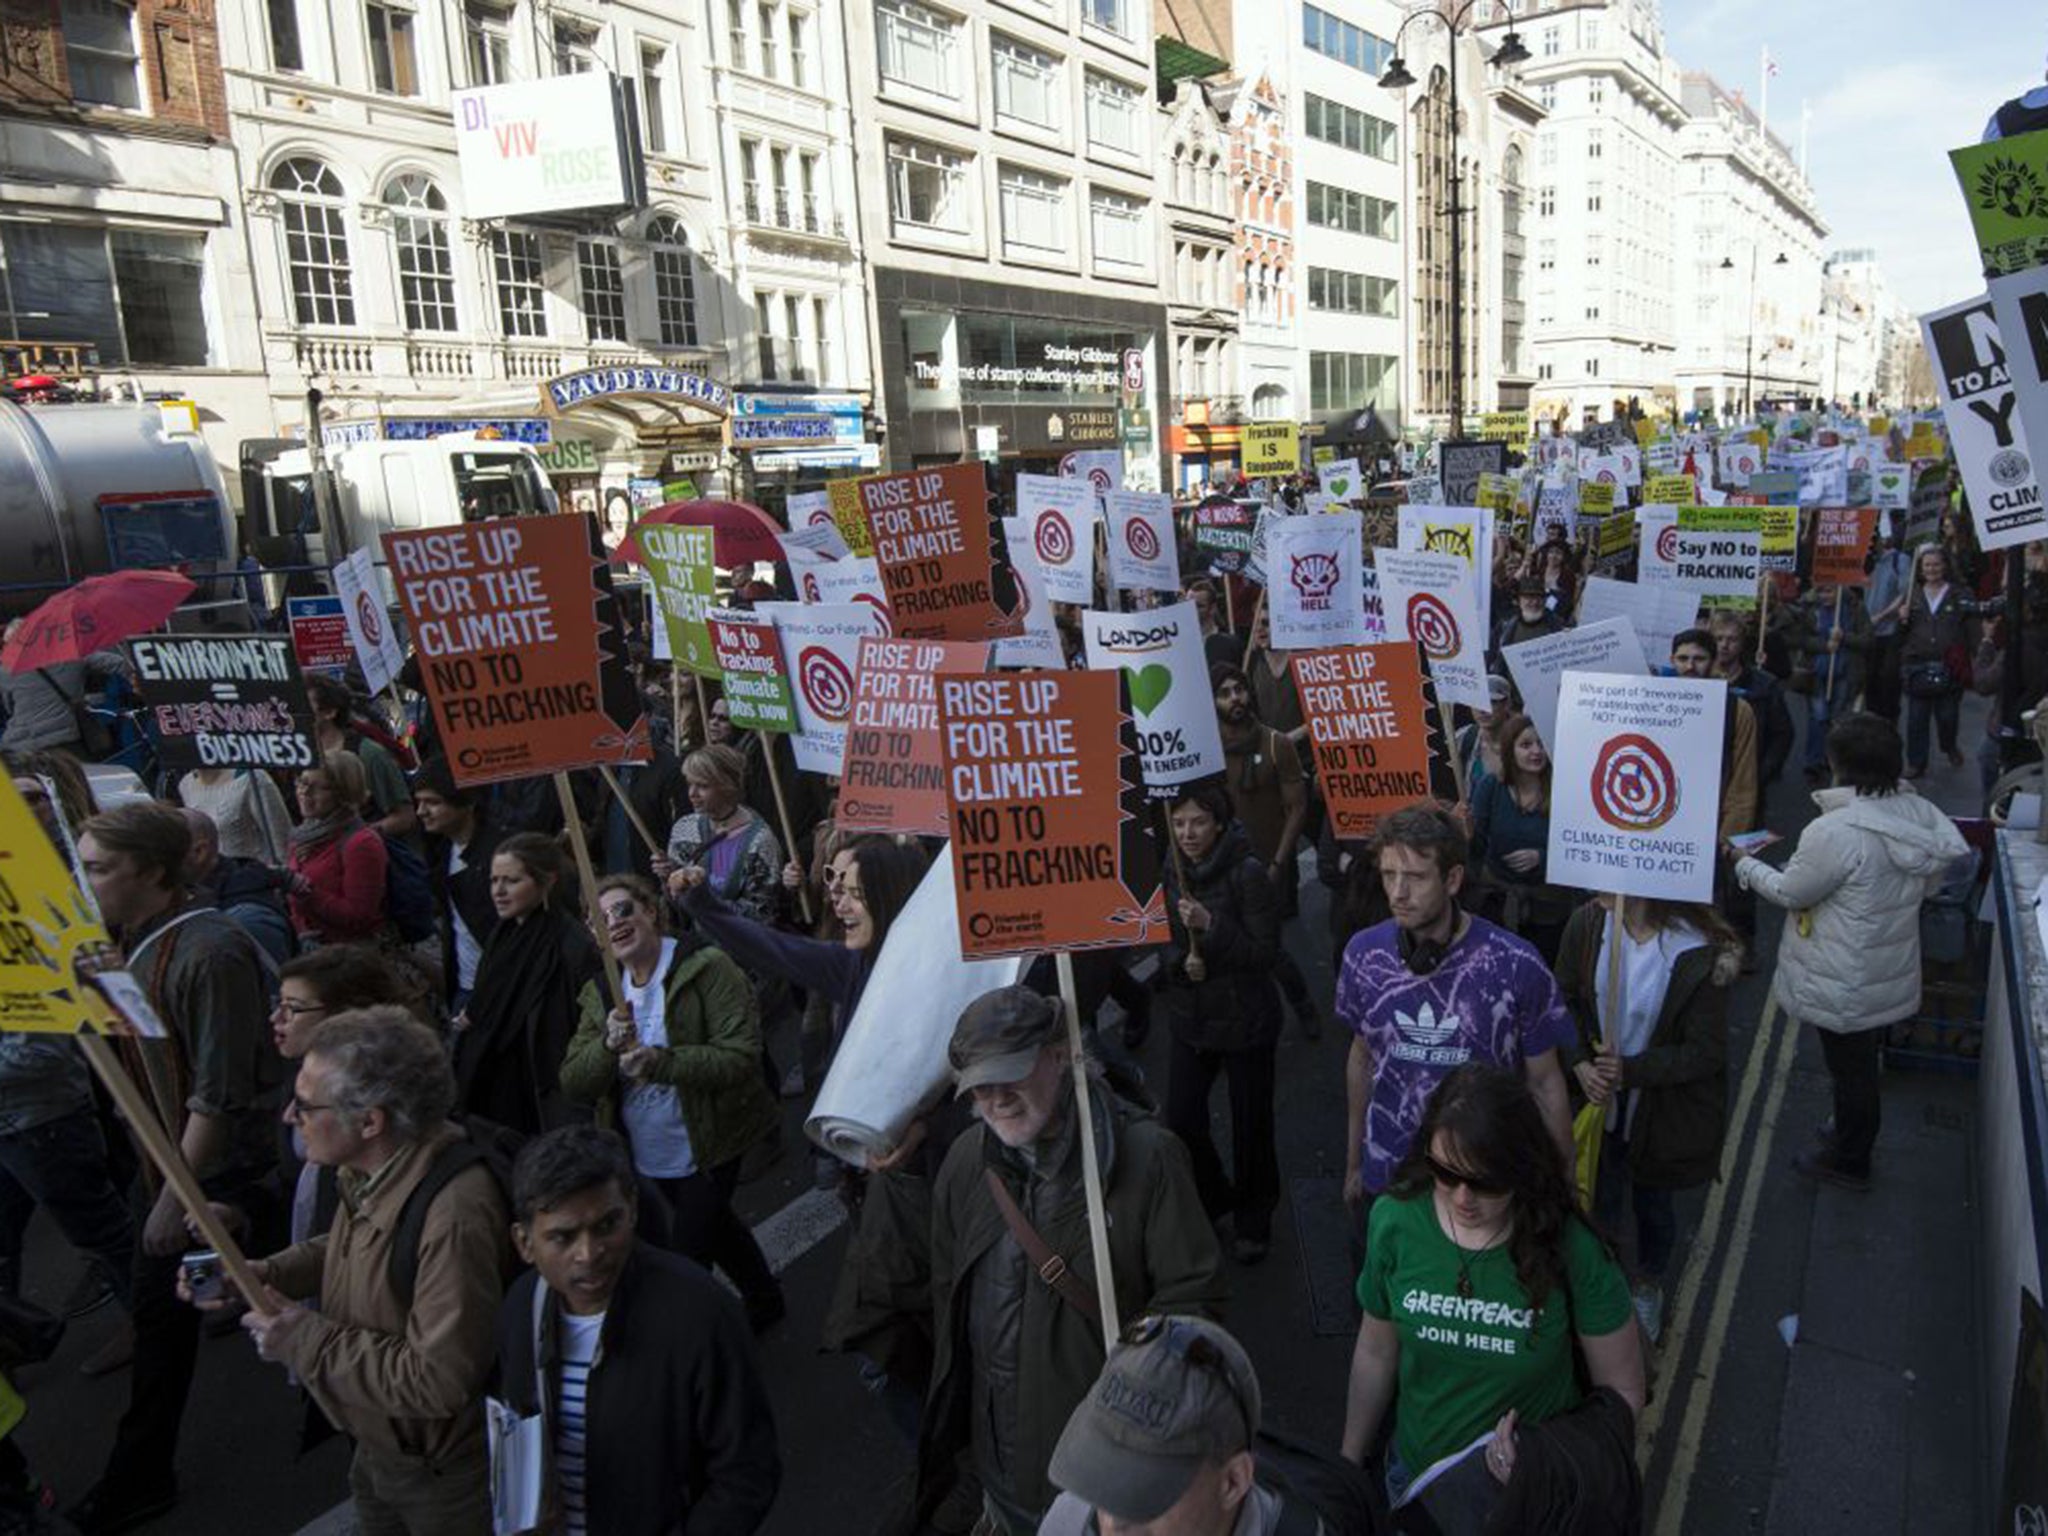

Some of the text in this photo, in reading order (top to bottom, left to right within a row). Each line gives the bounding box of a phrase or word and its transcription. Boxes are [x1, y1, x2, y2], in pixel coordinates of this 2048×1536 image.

[462, 96, 488, 131] DI
[494, 121, 537, 159] VIV
[541, 146, 611, 187] ROSE
[1044, 344, 1119, 365] Stanley Gibbons
[556, 369, 725, 406] VAUDEVILLE
[990, 369, 1023, 386] stamp
[1950, 376, 1983, 396] TO
[1069, 412, 1115, 426] STANLEY
[1070, 428, 1115, 440] GIBBONS
[541, 440, 595, 469] ROSE
[1262, 443, 1278, 457] IS
[864, 474, 943, 509] RISE UP
[871, 508, 914, 537] FOR
[915, 500, 959, 529] THE
[393, 528, 522, 576] RISE UP
[878, 527, 965, 564] CLIMATE
[1678, 540, 1757, 560] Say NO to
[885, 560, 943, 590] NO TO
[1677, 564, 1756, 580] FRACKING
[404, 567, 547, 617] FOR THE
[893, 580, 990, 617] FRACKING
[1301, 599, 1332, 612] HELL
[419, 607, 558, 657] CLIMATE
[718, 623, 760, 650] No to
[1098, 622, 1178, 650] LONDON
[132, 640, 289, 681] ENVIRONMENT
[862, 643, 944, 671] RISE UP
[1296, 652, 1376, 684] RISE UP
[430, 653, 523, 695] NO TO
[858, 671, 937, 700] FOR TH
[443, 681, 597, 733] FRACKING
[943, 680, 1059, 716] RISE UP
[1303, 681, 1392, 712] FOR THE
[154, 696, 295, 736] EVERYONE'S
[855, 702, 940, 730] CLIMATE
[1311, 711, 1400, 742] CLIMATE
[1592, 711, 1616, 722] NOT
[195, 733, 312, 767] BUSINESS
[852, 730, 912, 758] NO TO
[948, 719, 1076, 758] FOR THE
[1154, 752, 1201, 773] ENERGY
[1318, 744, 1377, 770] NO TO
[953, 760, 1082, 801] CLIMATE
[1326, 771, 1427, 799] FRACKING
[957, 805, 1045, 845] NO TO
[1562, 830, 1625, 850] CLIMATE
[962, 843, 1115, 891] FRACKING
[1565, 847, 1696, 874] IT'S TIME TO ACT!
[1416, 1326, 1516, 1354] JOIN HERE
